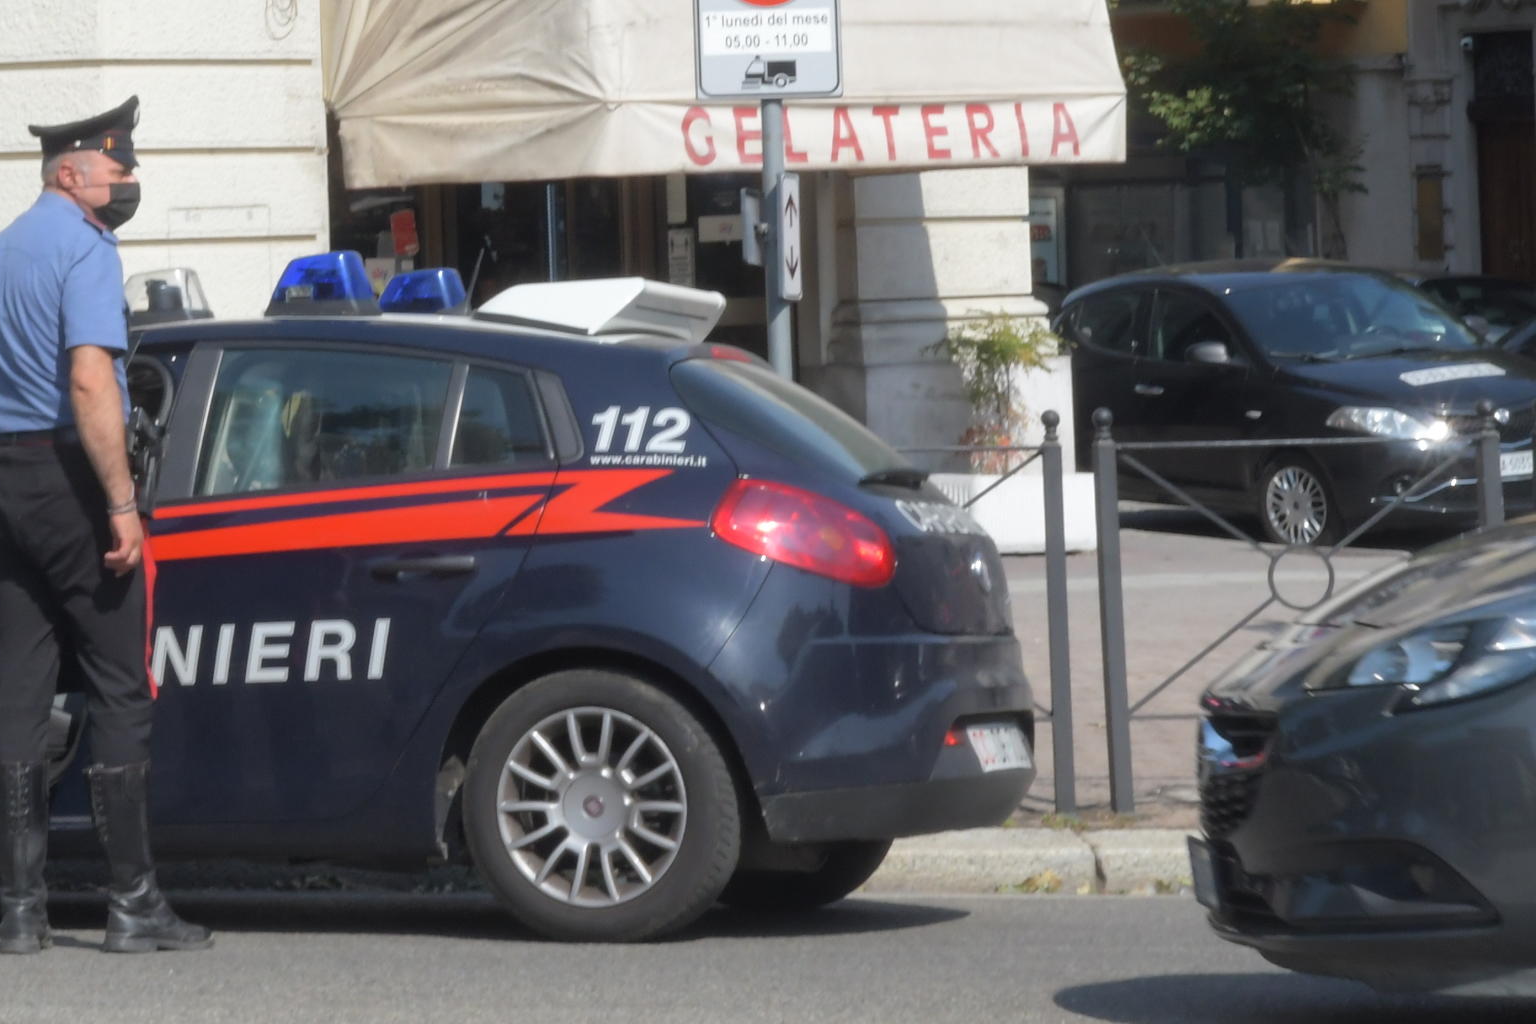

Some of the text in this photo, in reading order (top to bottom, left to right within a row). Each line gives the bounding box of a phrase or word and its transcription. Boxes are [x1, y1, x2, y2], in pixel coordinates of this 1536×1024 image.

[767, 12, 788, 26] del
[792, 13, 829, 25] mese
[681, 102, 1080, 166] GELATERIA
[591, 405, 691, 454] 112
[590, 454, 707, 467] www.carabinieri.it
